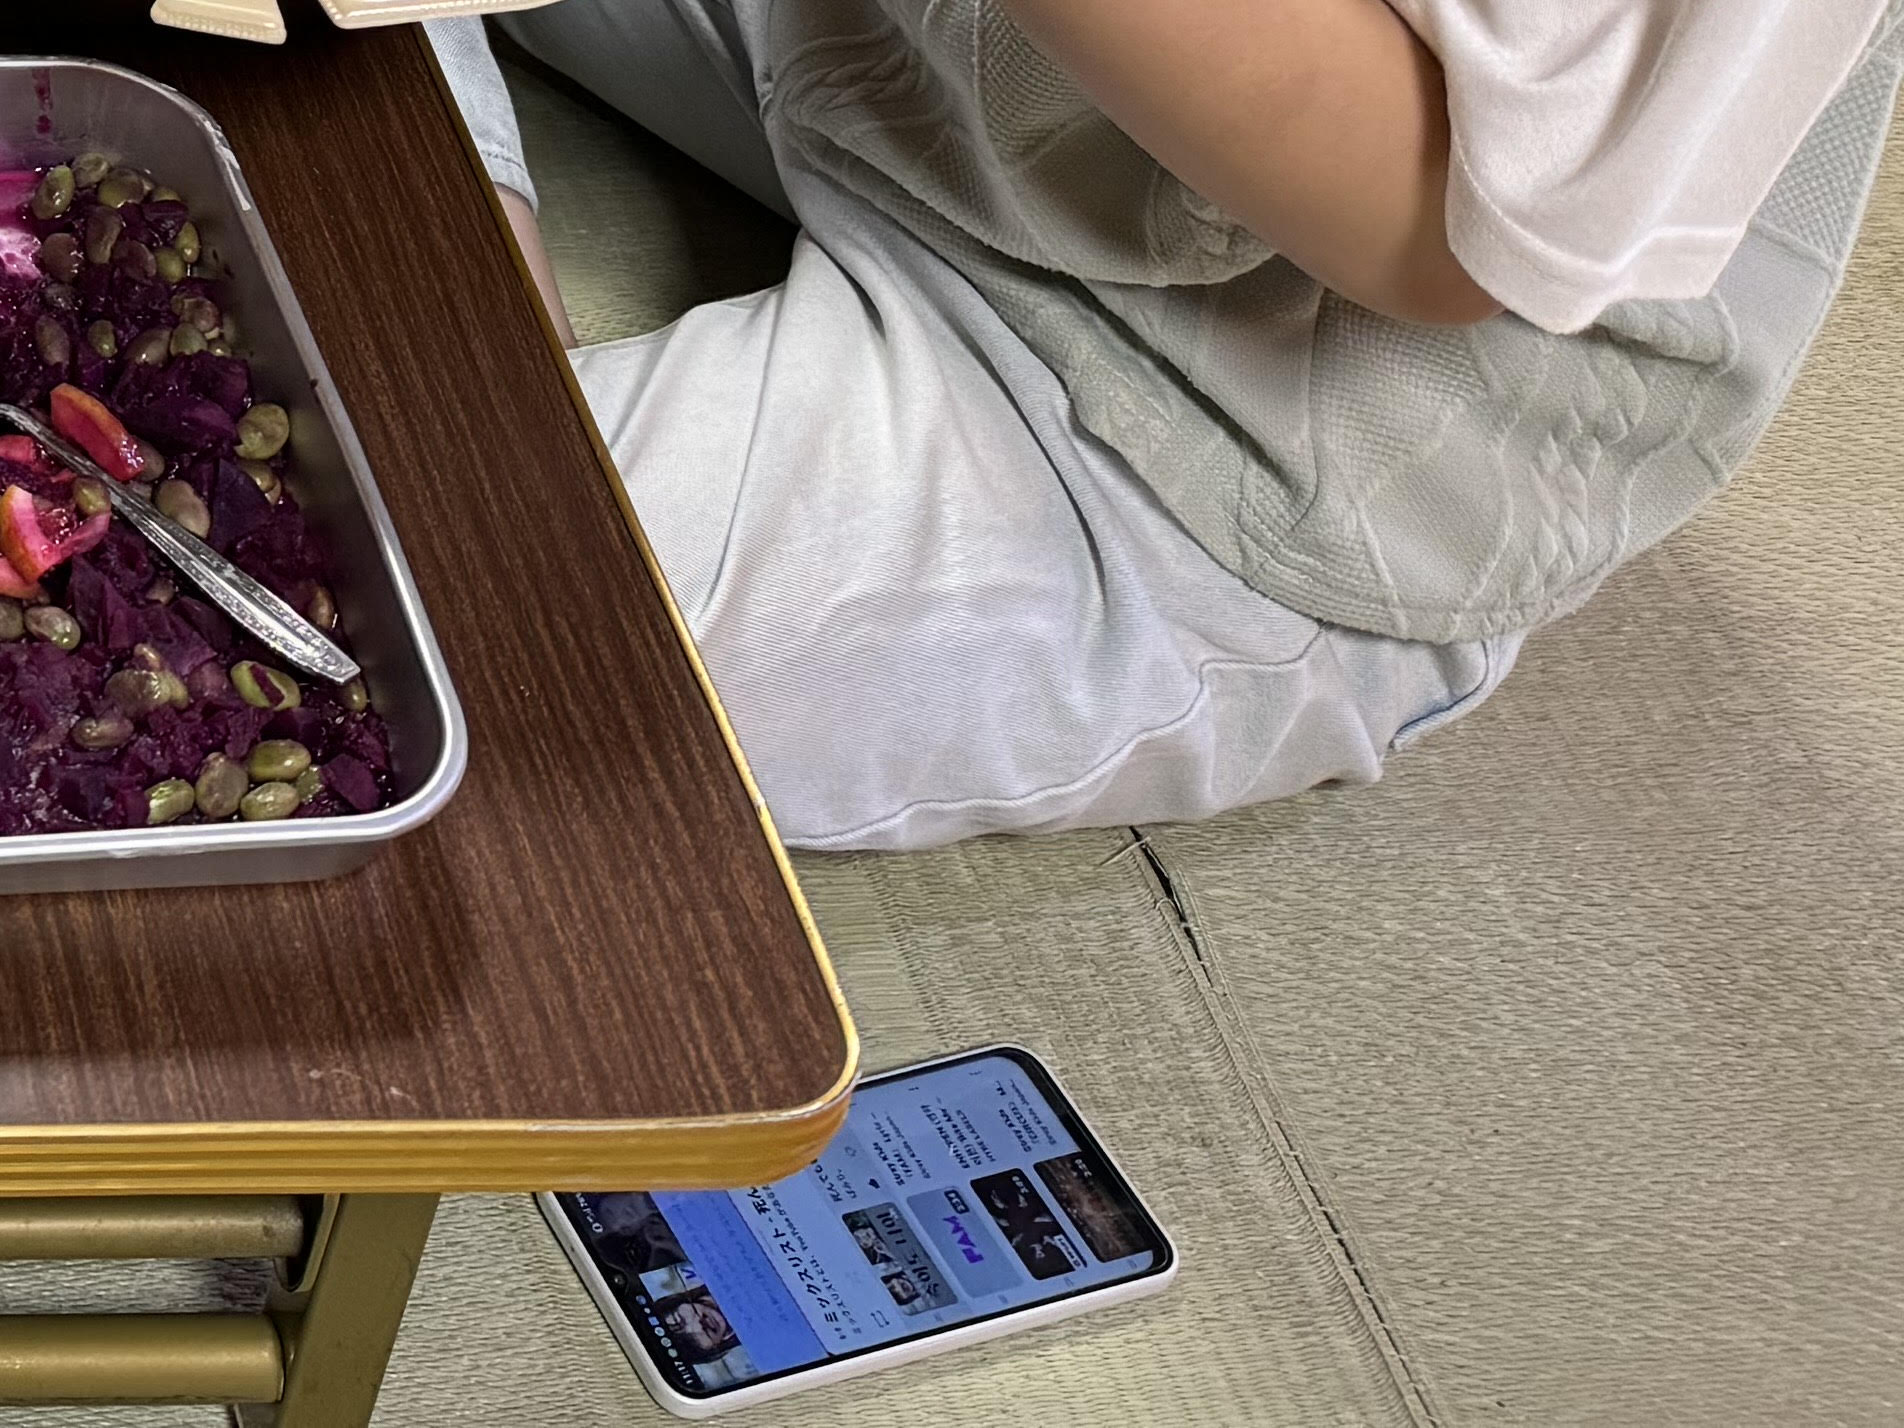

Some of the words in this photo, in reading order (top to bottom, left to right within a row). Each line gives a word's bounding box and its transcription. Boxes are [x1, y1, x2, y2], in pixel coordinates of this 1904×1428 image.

[767, 1226, 841, 1324] ミックスリスト
[941, 1214, 985, 1264] FAM
